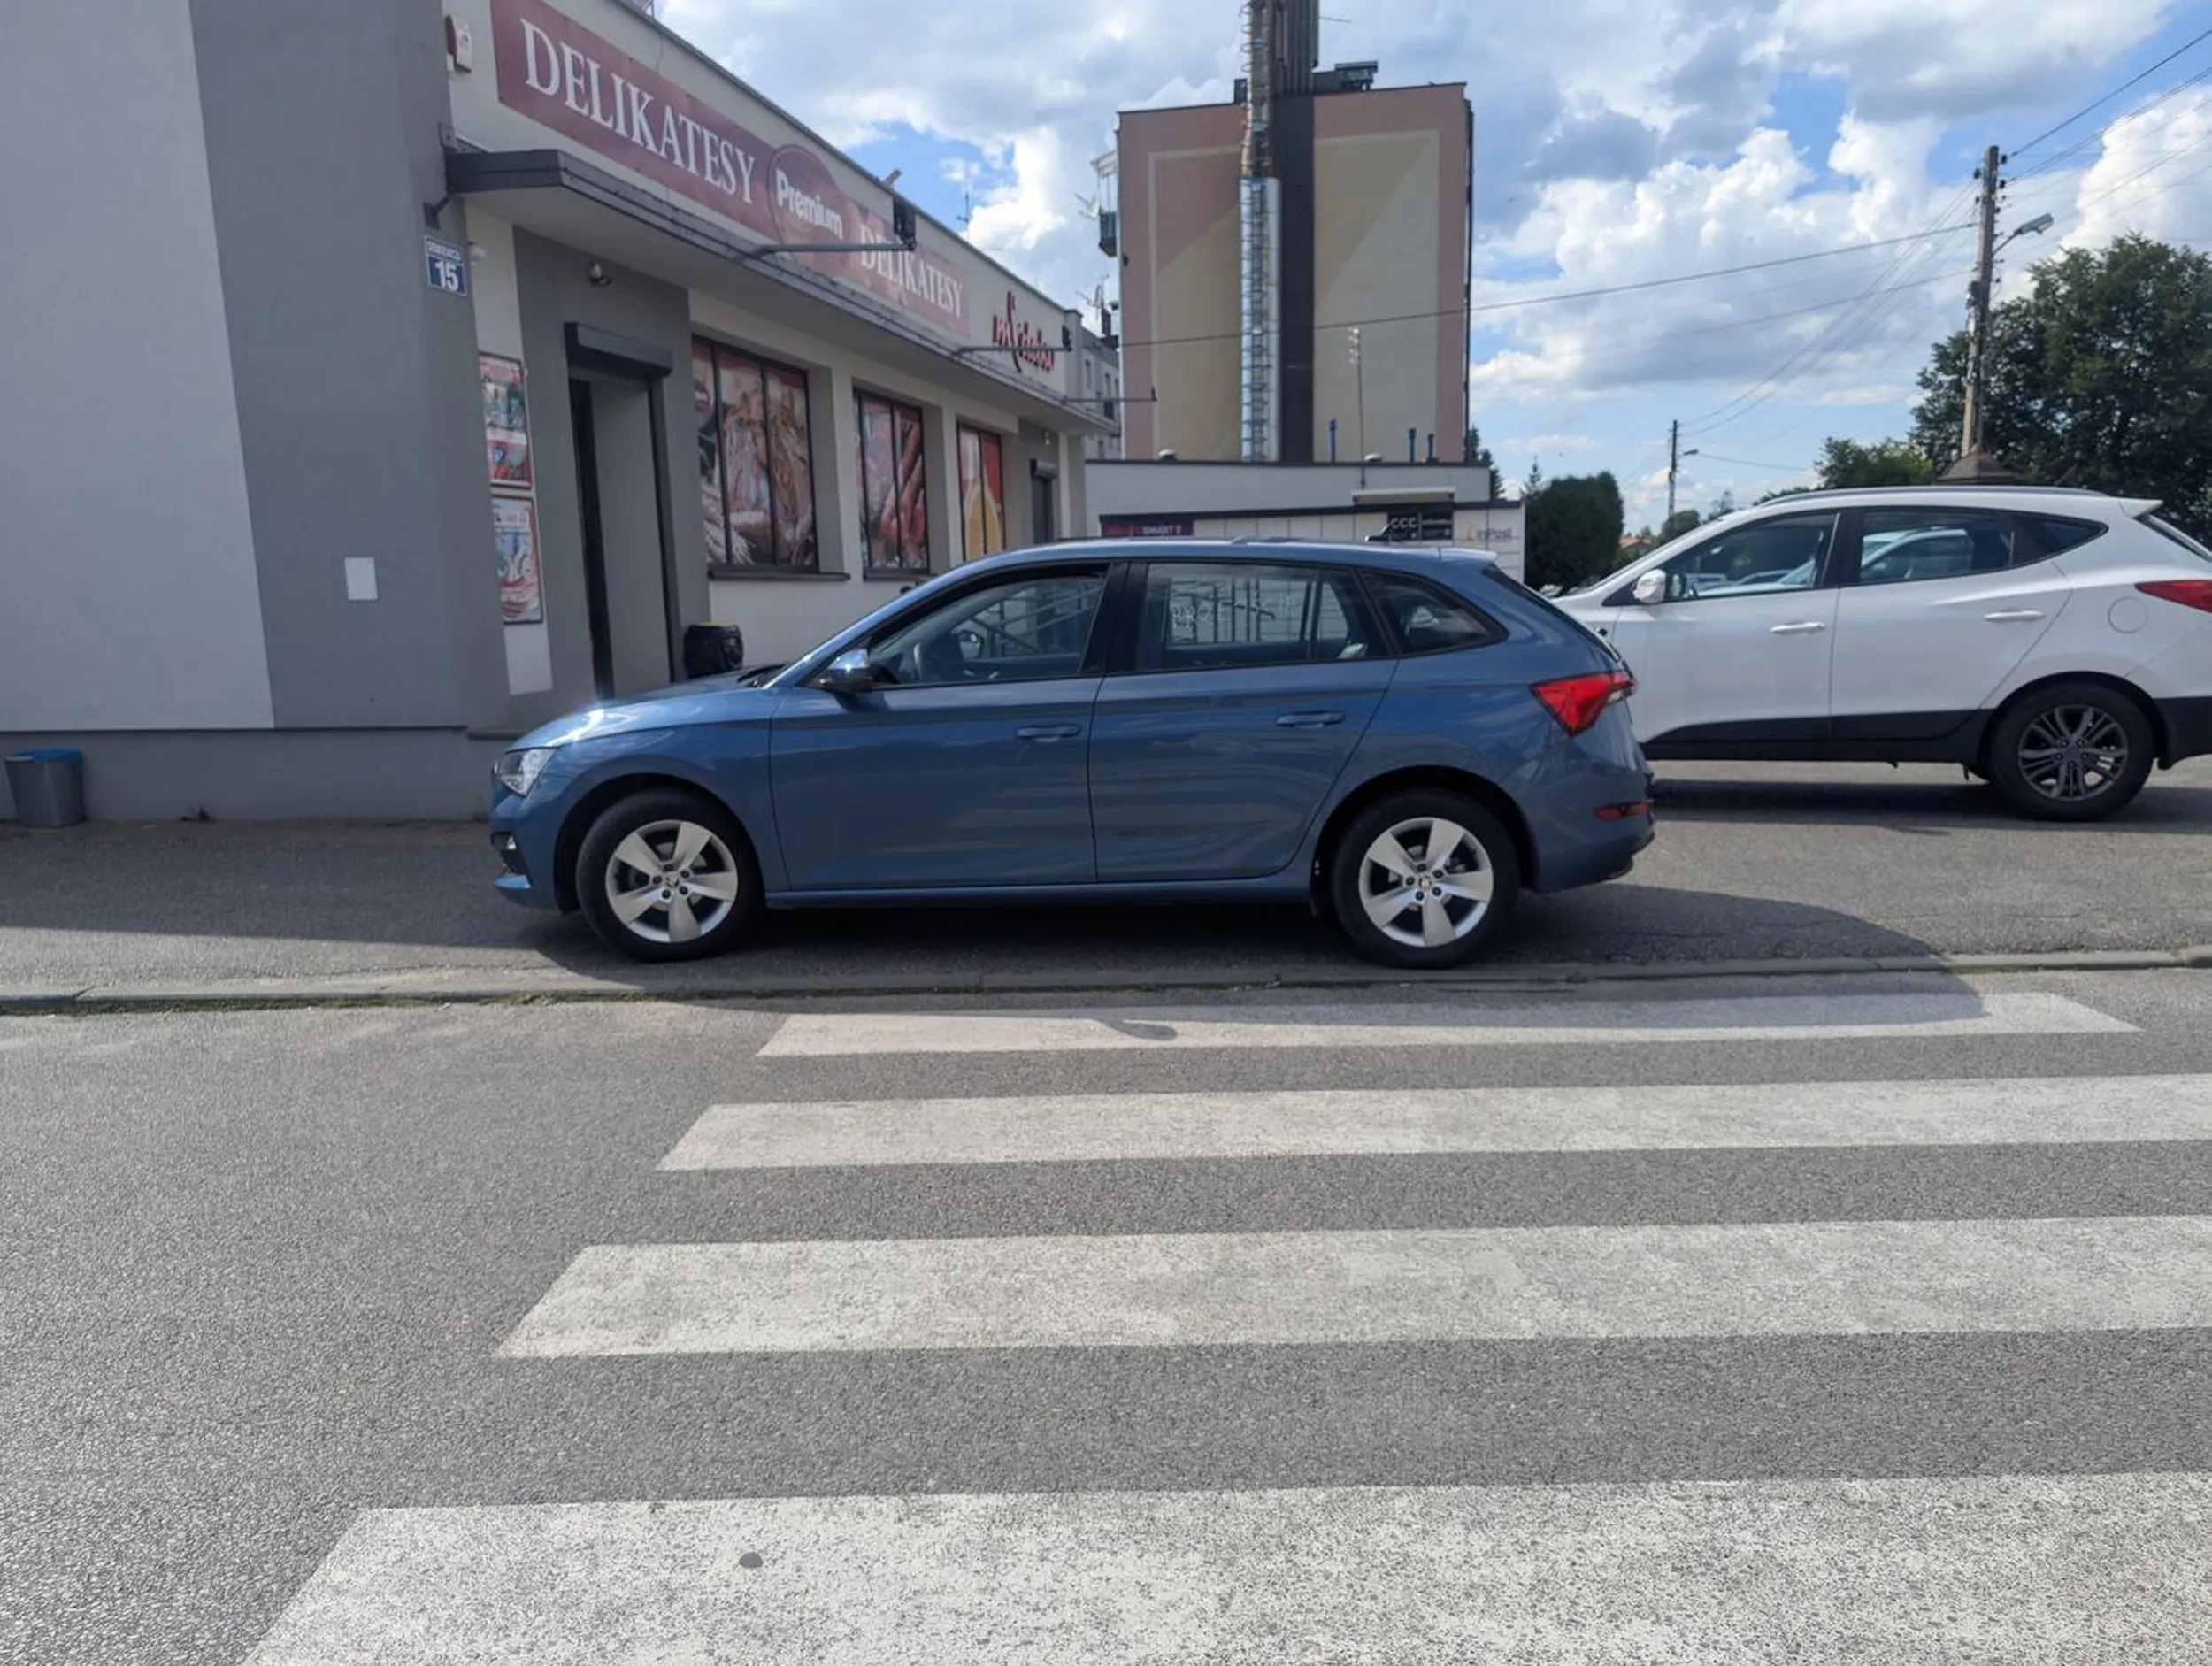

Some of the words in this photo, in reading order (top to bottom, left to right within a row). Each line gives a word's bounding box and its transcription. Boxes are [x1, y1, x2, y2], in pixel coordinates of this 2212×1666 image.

[520, 19, 756, 204] DELIKATESY
[775, 169, 843, 240] Premium
[434, 259, 459, 292] 15
[859, 225, 963, 318] DELIKATESY
